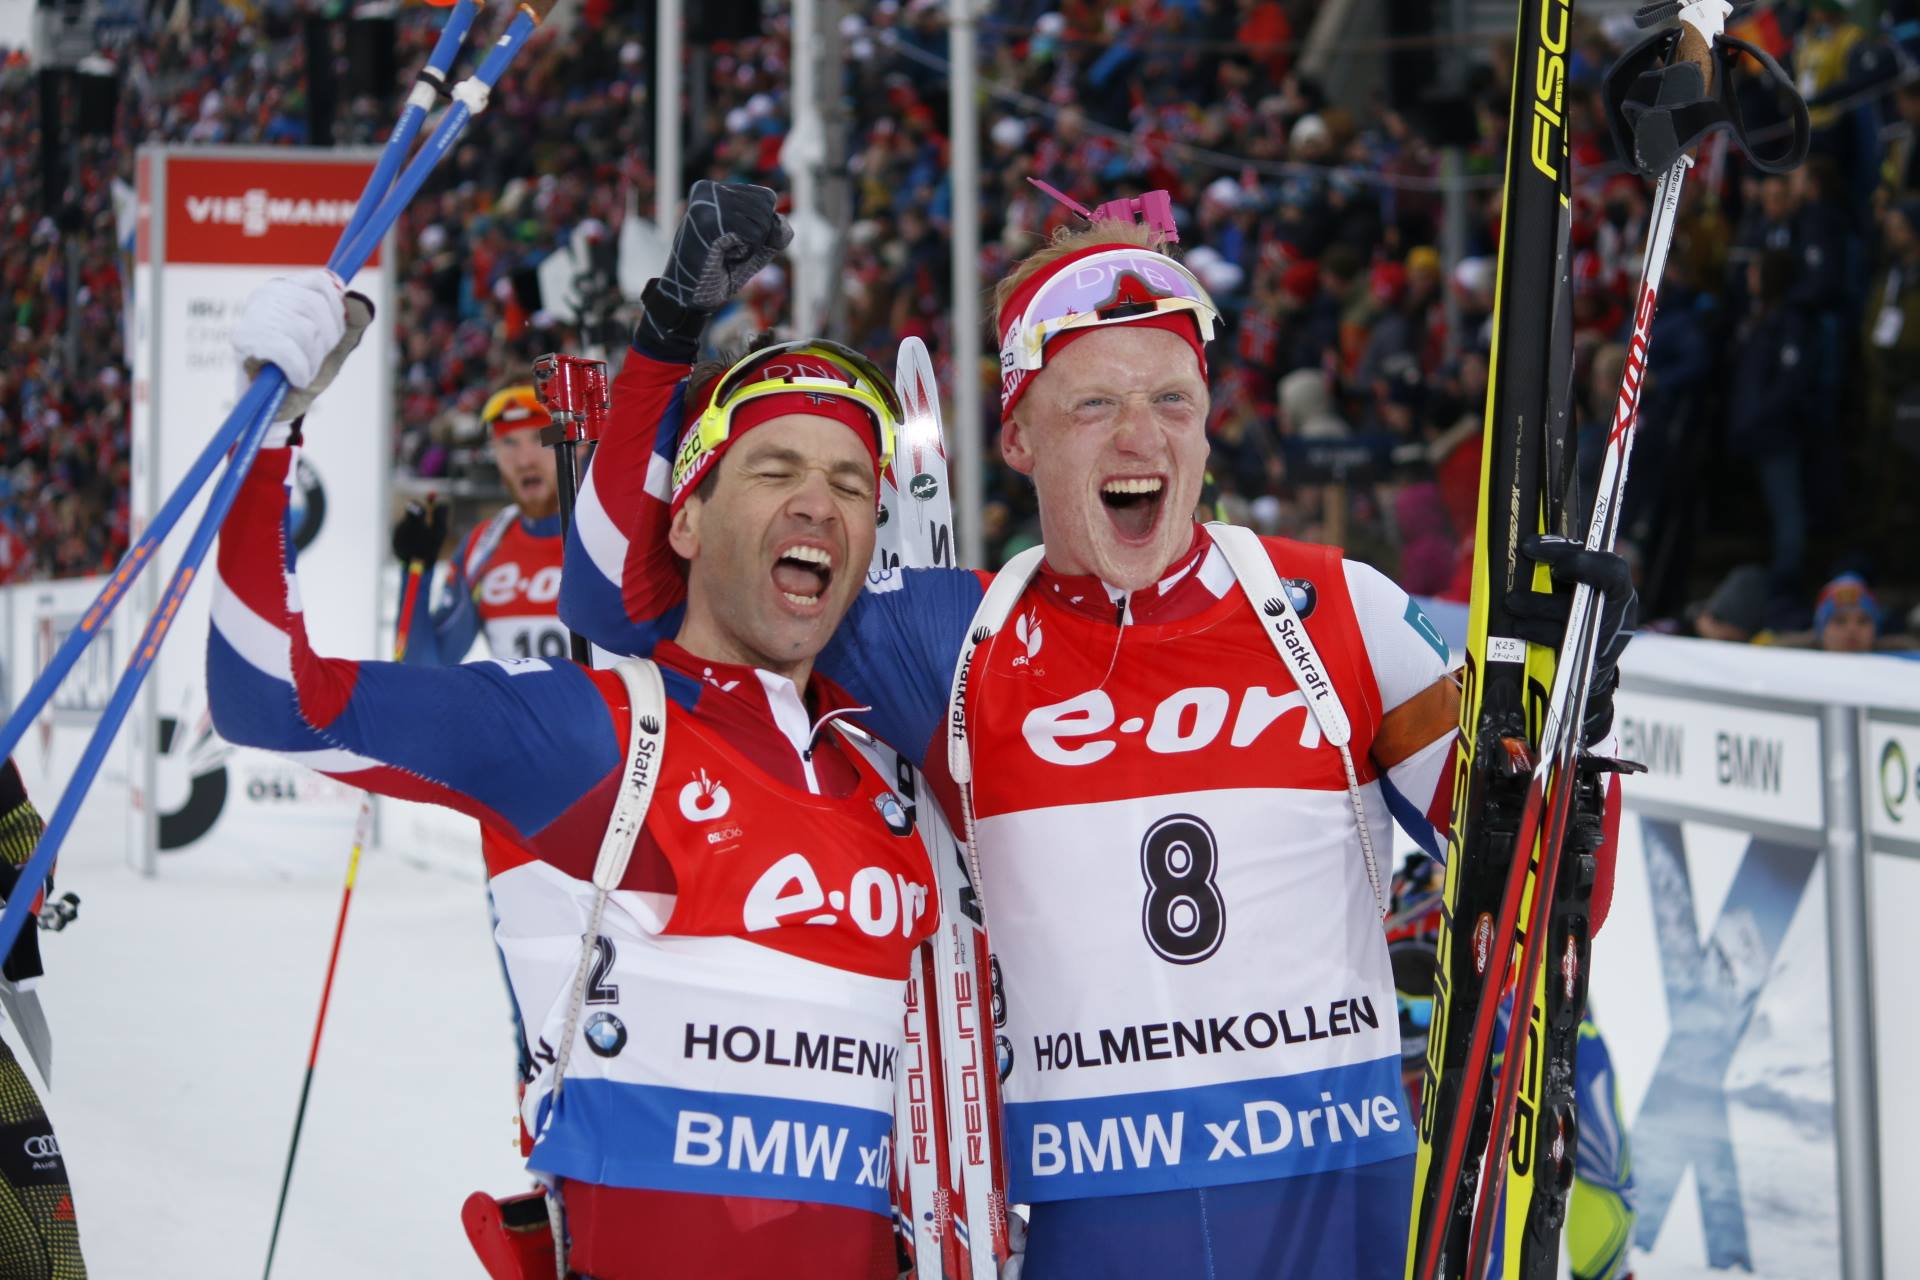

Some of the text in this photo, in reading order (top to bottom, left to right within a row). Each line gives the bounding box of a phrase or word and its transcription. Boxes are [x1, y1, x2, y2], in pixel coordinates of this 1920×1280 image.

[1532, 0, 1570, 181] FISC
[1275, 618, 1329, 701] Statkraft
[1717, 730, 1784, 793] BMW
[1141, 813, 1227, 966] 8
[1420, 648, 1477, 1145] FISCHER
[582, 934, 620, 1005] 2
[684, 1022, 899, 1083] HOLMENK
[954, 971, 985, 1166] REDLINE
[1034, 995, 1380, 1073] HOLMENKOLLEN
[673, 1109, 893, 1191] BMW xD
[1031, 1092, 1401, 1177] BMW xDrive
